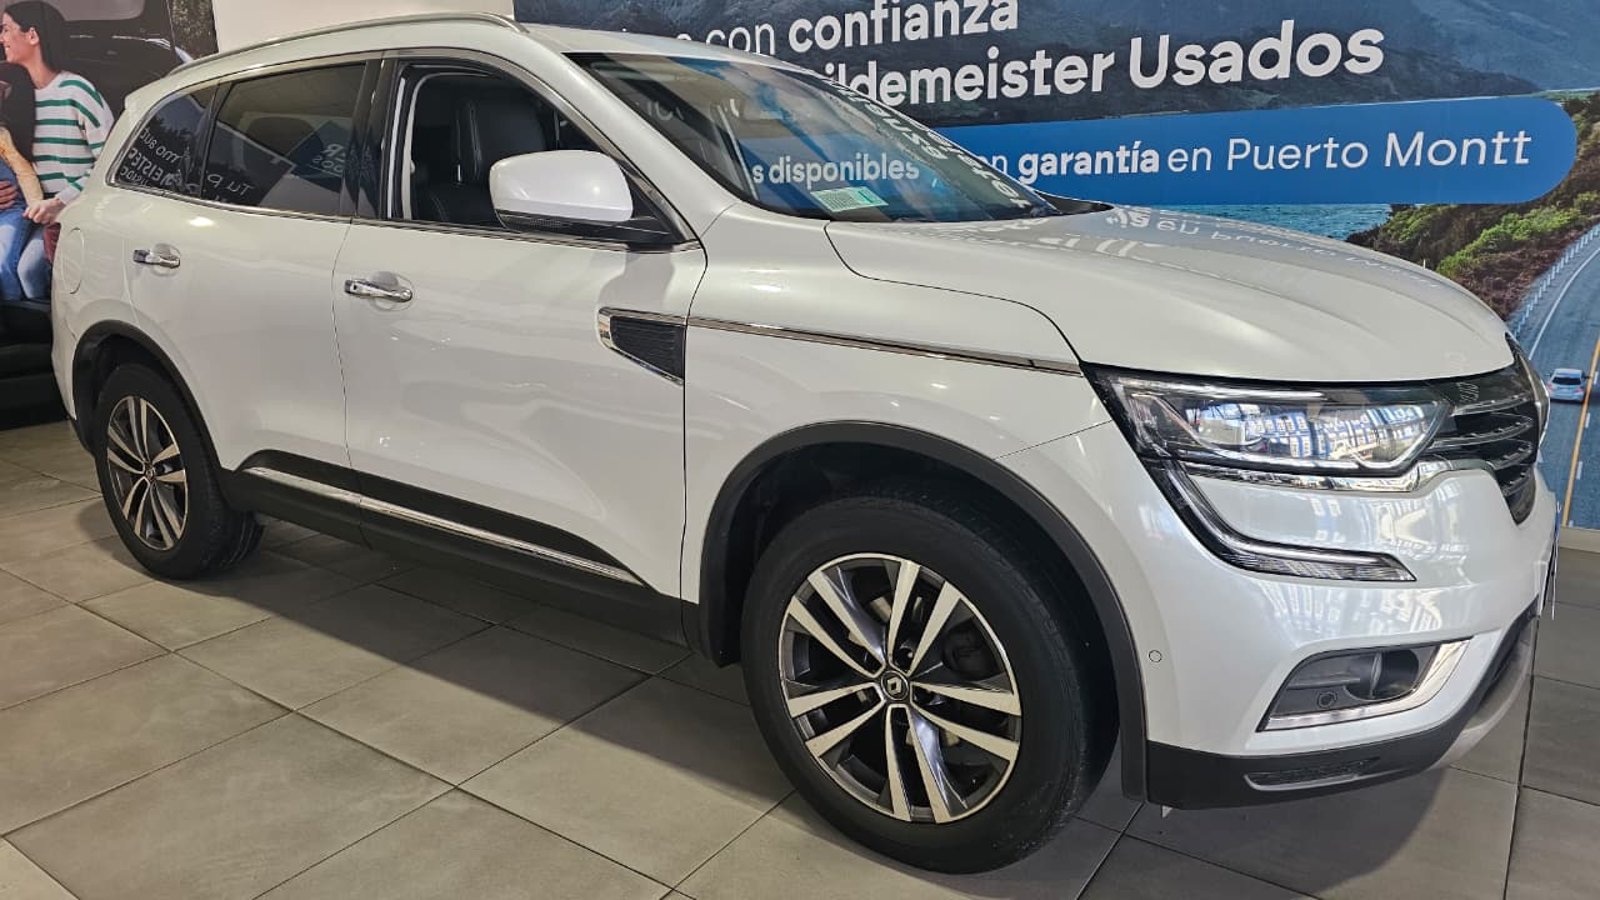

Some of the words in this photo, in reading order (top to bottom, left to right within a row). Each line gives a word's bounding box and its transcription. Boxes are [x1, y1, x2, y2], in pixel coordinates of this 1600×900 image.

[788, 0, 1019, 53] confianza
[1129, 20, 1385, 89] Usados
[769, 153, 919, 189] disponibles
[1018, 140, 1160, 184] garantía
[1168, 149, 1212, 171] en
[1227, 138, 1369, 170] Puerto
[1384, 129, 1532, 167] Montt
